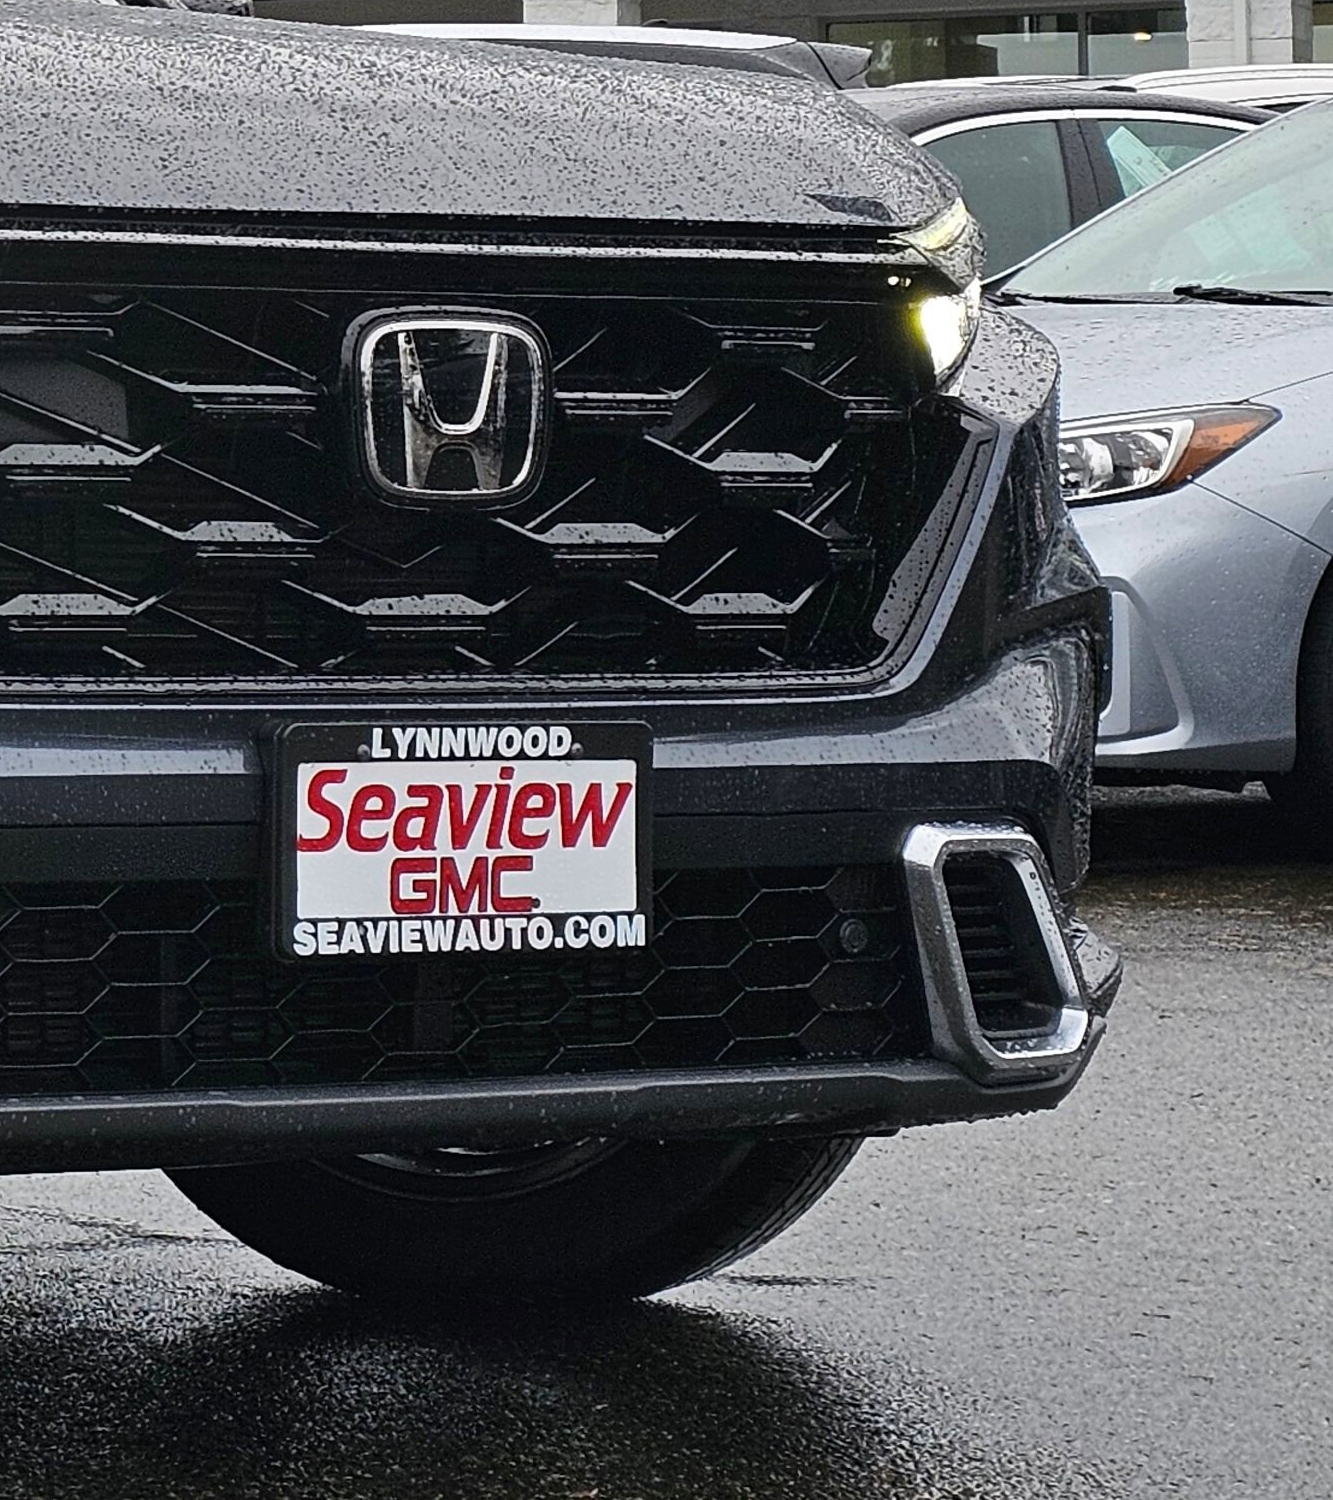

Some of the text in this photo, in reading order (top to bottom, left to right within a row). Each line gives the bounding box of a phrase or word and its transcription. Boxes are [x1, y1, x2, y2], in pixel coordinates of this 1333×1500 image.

[371, 726, 573, 759] LYNNWOOD
[296, 766, 634, 853] Seaview
[390, 855, 534, 915] GMC
[292, 914, 647, 957] SEAVIEWAUTO.COM
